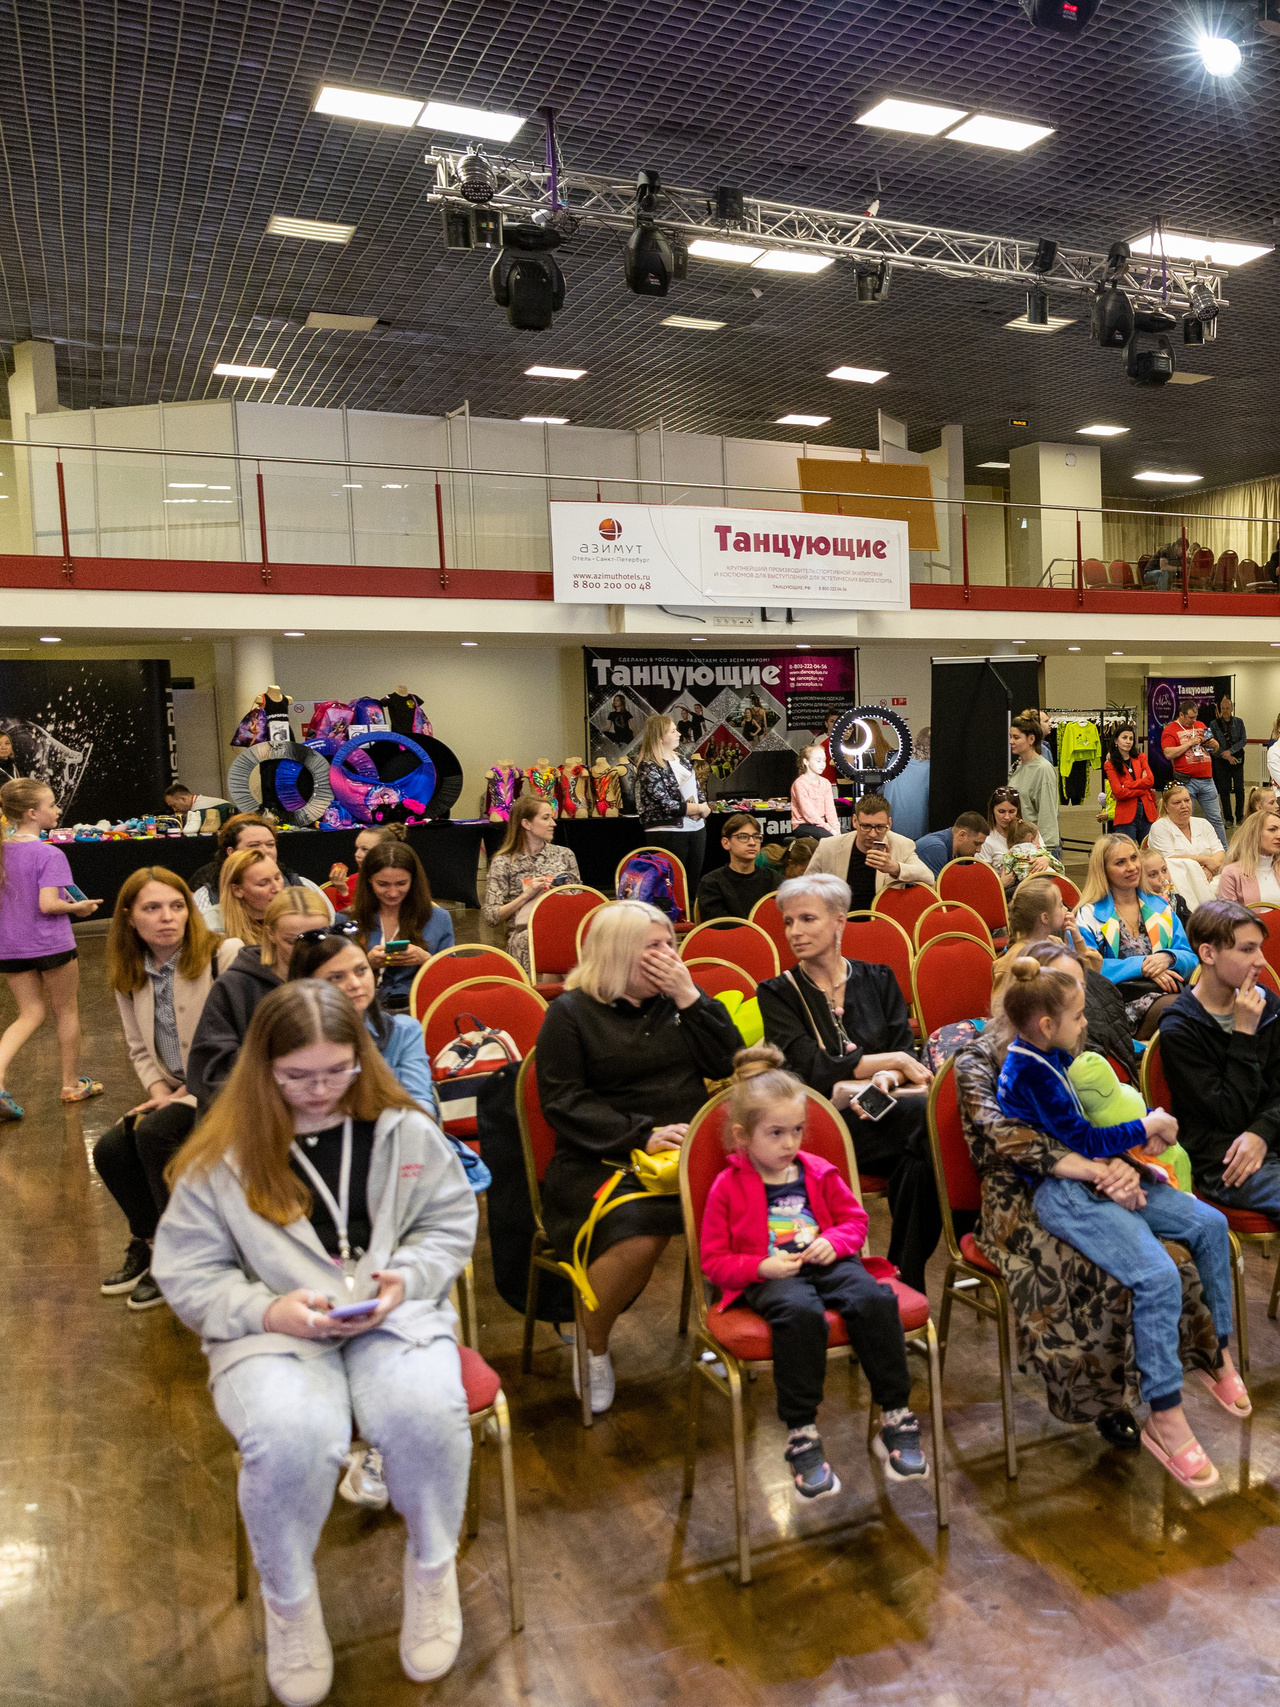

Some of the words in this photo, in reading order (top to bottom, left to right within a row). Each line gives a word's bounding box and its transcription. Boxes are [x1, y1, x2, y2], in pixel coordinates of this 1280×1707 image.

[714, 525, 887, 560] Танцующие
[726, 564, 767, 572] КРУПНЕЙШИЙ
[769, 566, 815, 574] ПРОИЗВОДИТЕЛЬ
[572, 572, 650, 581] www.azimuthotels.ru
[573, 580, 579, 589] 8
[582, 580, 601, 589] 800
[603, 582, 622, 590] 200
[624, 582, 637, 590] 00
[639, 581, 652, 591] 48
[592, 658, 780, 691] Танцующие
[1178, 685, 1214, 696] Танцующие
